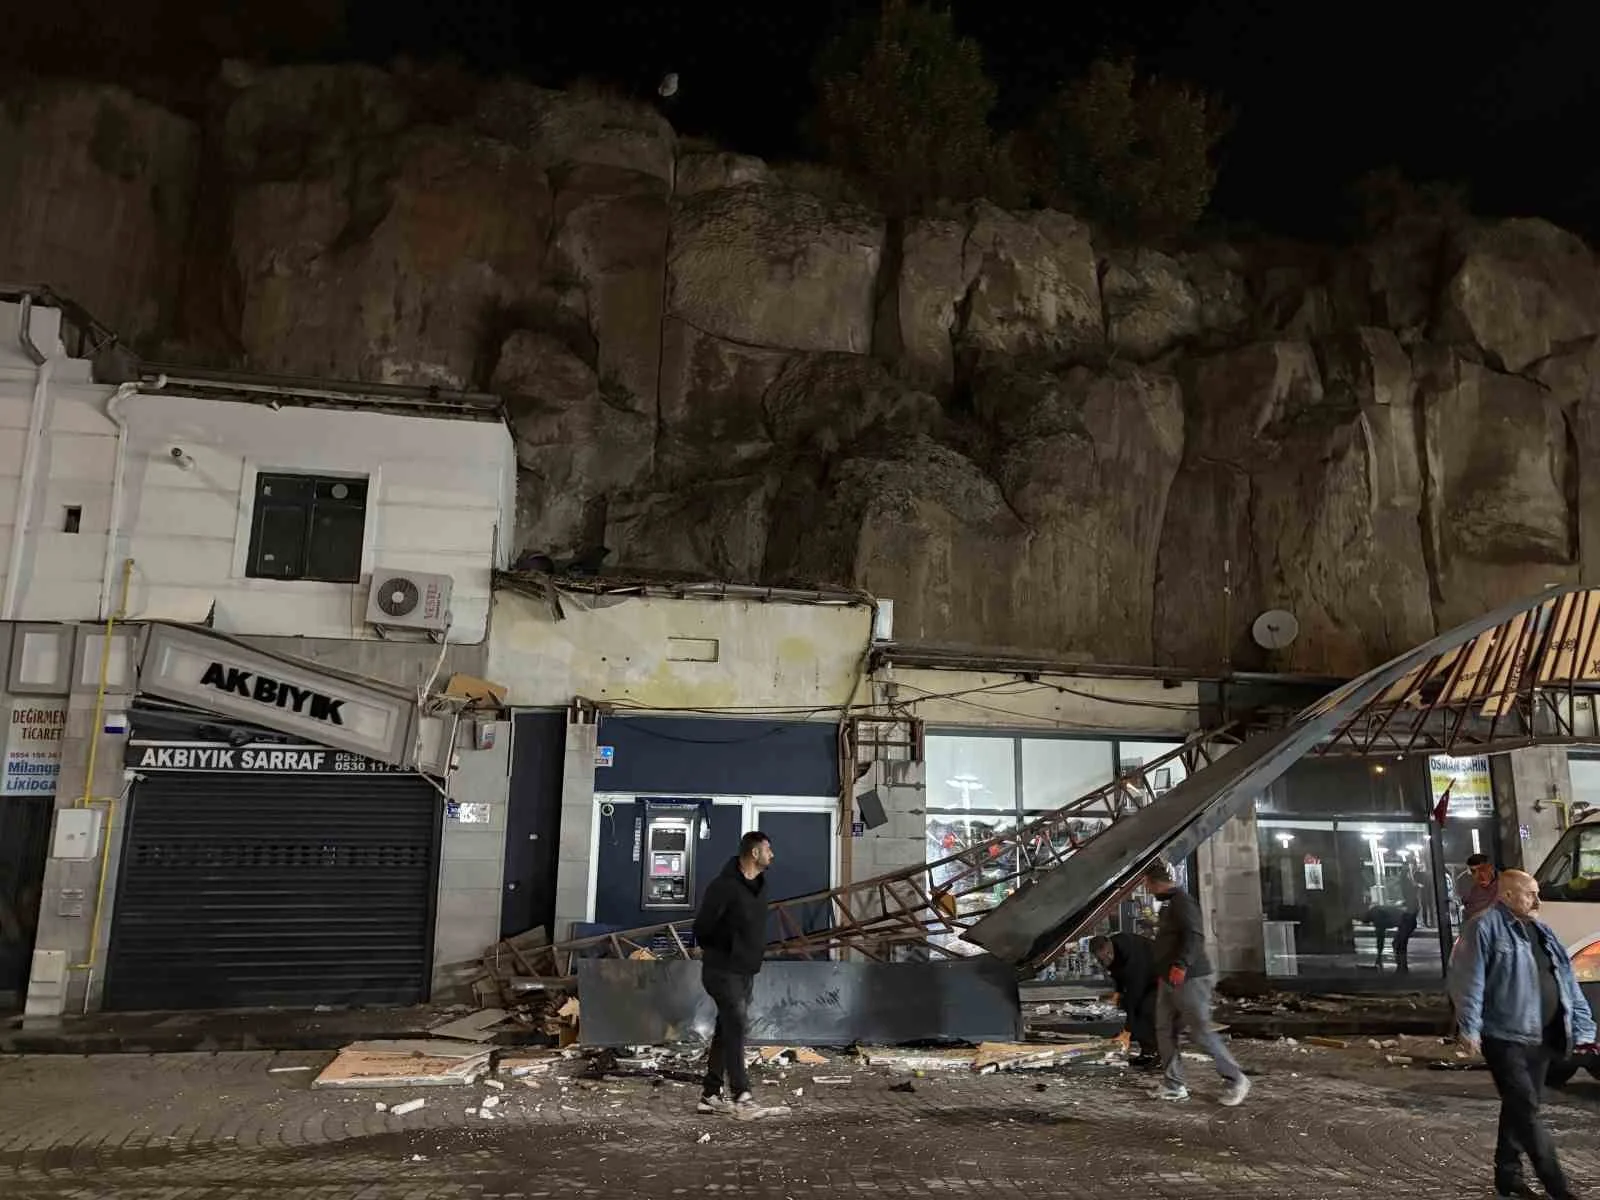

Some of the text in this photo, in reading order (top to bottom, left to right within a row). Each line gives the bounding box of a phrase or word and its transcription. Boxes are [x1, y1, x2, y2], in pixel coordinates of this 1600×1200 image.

[200, 662, 345, 725] AKBIYIK
[22, 726, 64, 741] TİCARET
[140, 748, 325, 770] AKBIYIK SARRAF
[335, 762, 365, 771] 0530
